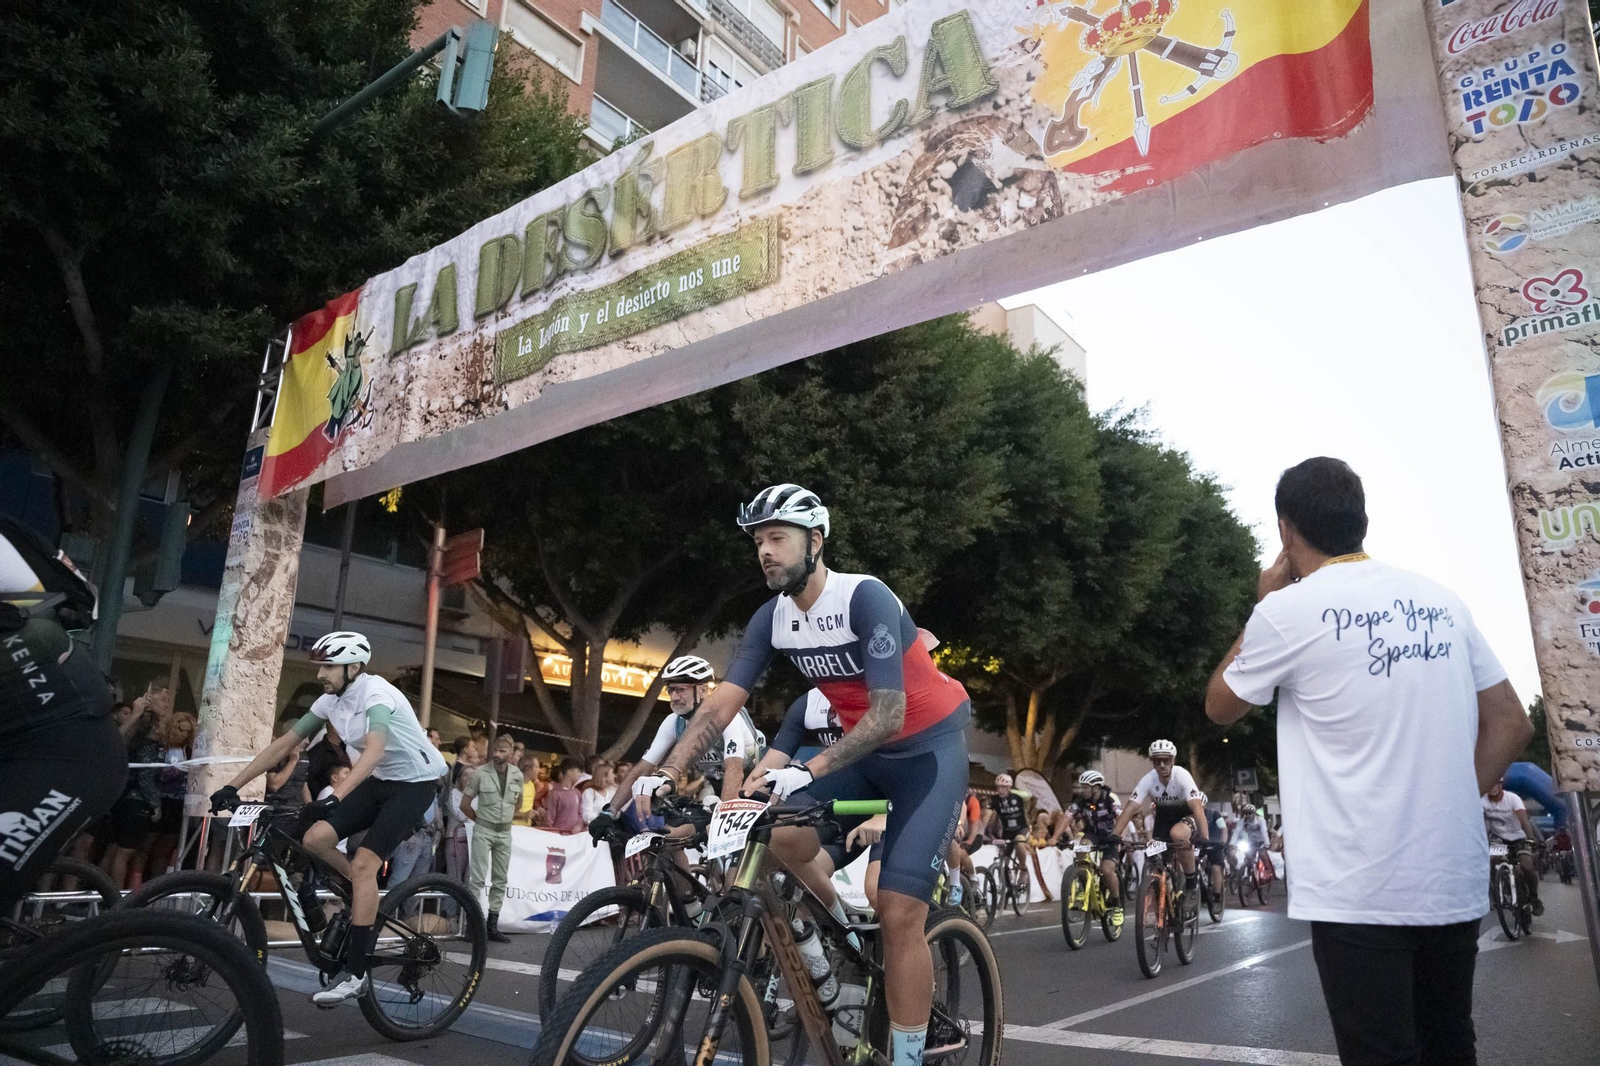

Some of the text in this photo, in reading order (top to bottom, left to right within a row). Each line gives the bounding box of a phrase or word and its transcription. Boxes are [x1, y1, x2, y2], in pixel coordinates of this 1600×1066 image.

[1461, 43, 1567, 88] GRUPO
[1463, 58, 1576, 111] RENTA
[1466, 82, 1580, 135] TODO
[389, 262, 459, 360] LA
[517, 335, 532, 357] La
[578, 313, 588, 334] y
[596, 301, 609, 325] el
[616, 281, 670, 318] desierto
[678, 267, 703, 293] nos
[711, 254, 741, 280] une
[816, 613, 845, 632] GCM
[1322, 608, 1394, 640] Pepe
[3, 633, 56, 706] KENZA
[790, 651, 865, 679] ARBELL
[1367, 631, 1452, 678] Speaker
[717, 811, 758, 837] 7542
[561, 890, 573, 901] DE
